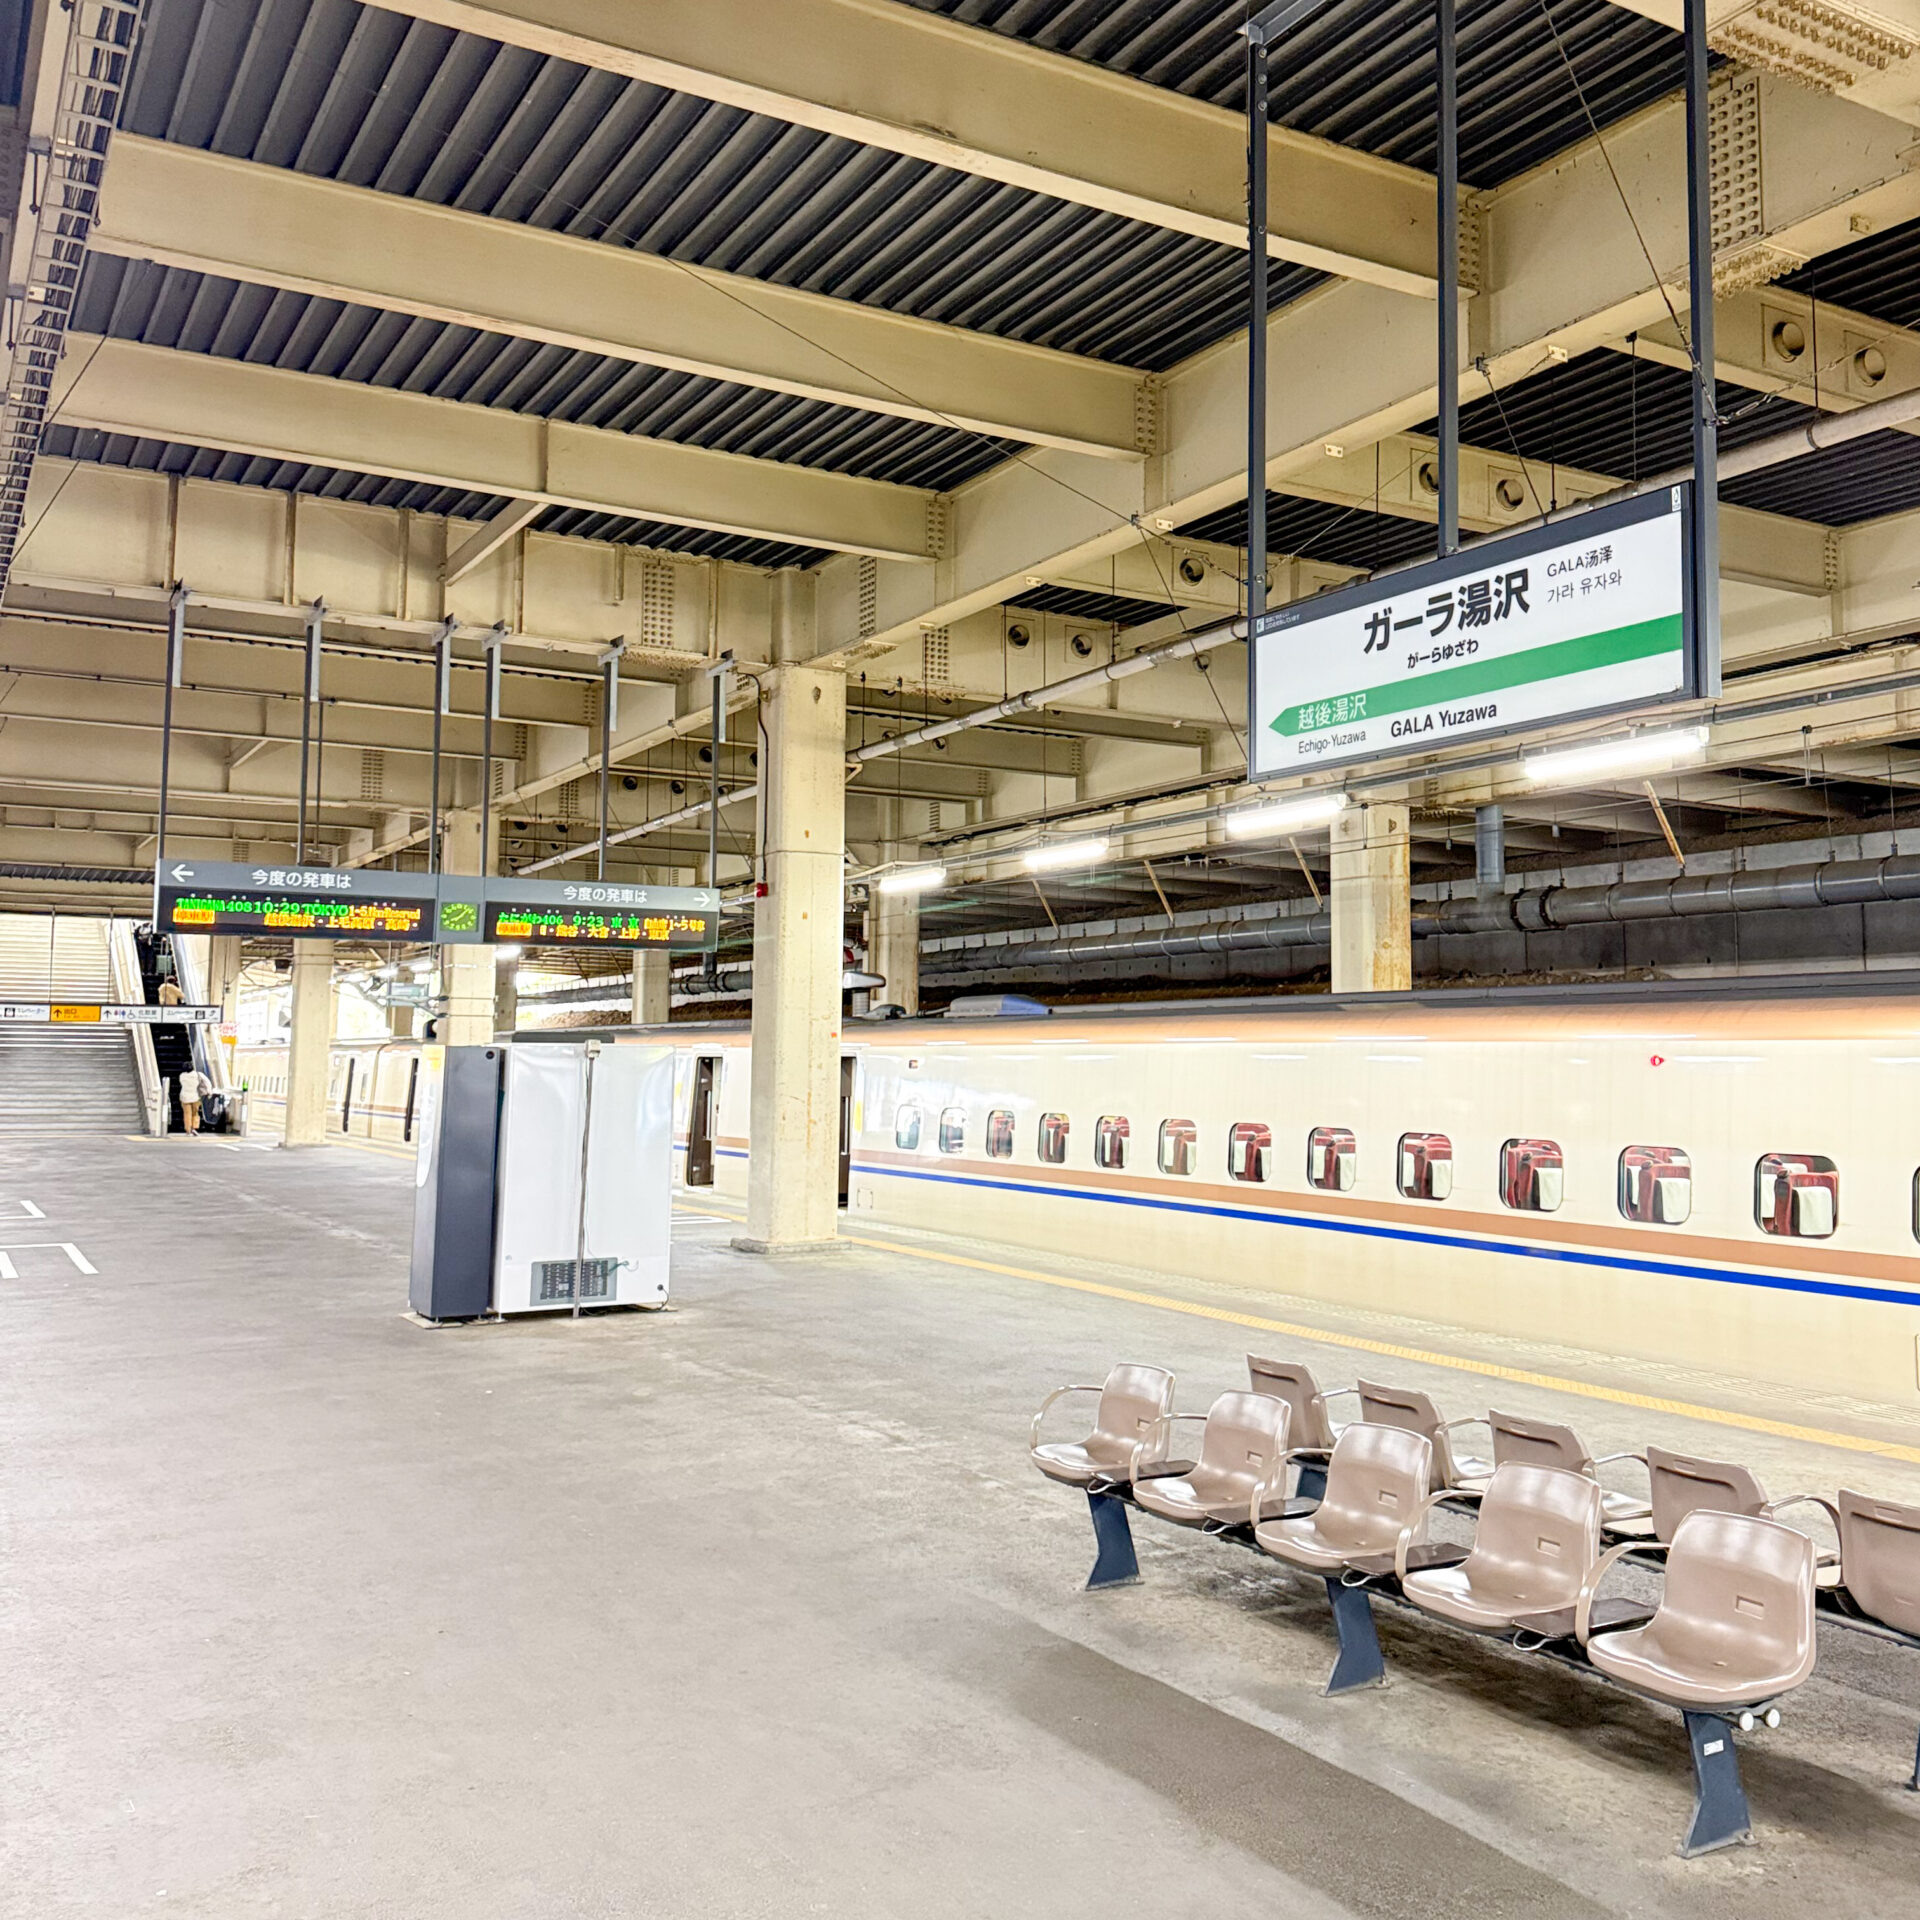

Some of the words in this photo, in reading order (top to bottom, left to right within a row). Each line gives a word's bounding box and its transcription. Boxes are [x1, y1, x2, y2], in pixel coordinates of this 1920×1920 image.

[1547, 545, 1613, 577] GALA汤泽
[1547, 582, 1574, 603] 가라
[1580, 569, 1622, 595] 유자와
[1364, 568, 1530, 654] ガーラ湯沢
[1407, 638, 1479, 669] がーらゆざわ
[1298, 693, 1367, 731] 越後湯沢
[1390, 714, 1434, 738] GALA
[1439, 704, 1497, 727] Yuzawa
[1298, 730, 1367, 754] Echigo-Yuzawa
[251, 869, 352, 889] 今度の発車は
[563, 885, 648, 904] 今度の発車は
[254, 901, 300, 915] 10:29
[301, 903, 349, 917] TOKYO
[573, 914, 604, 927] 9:23
